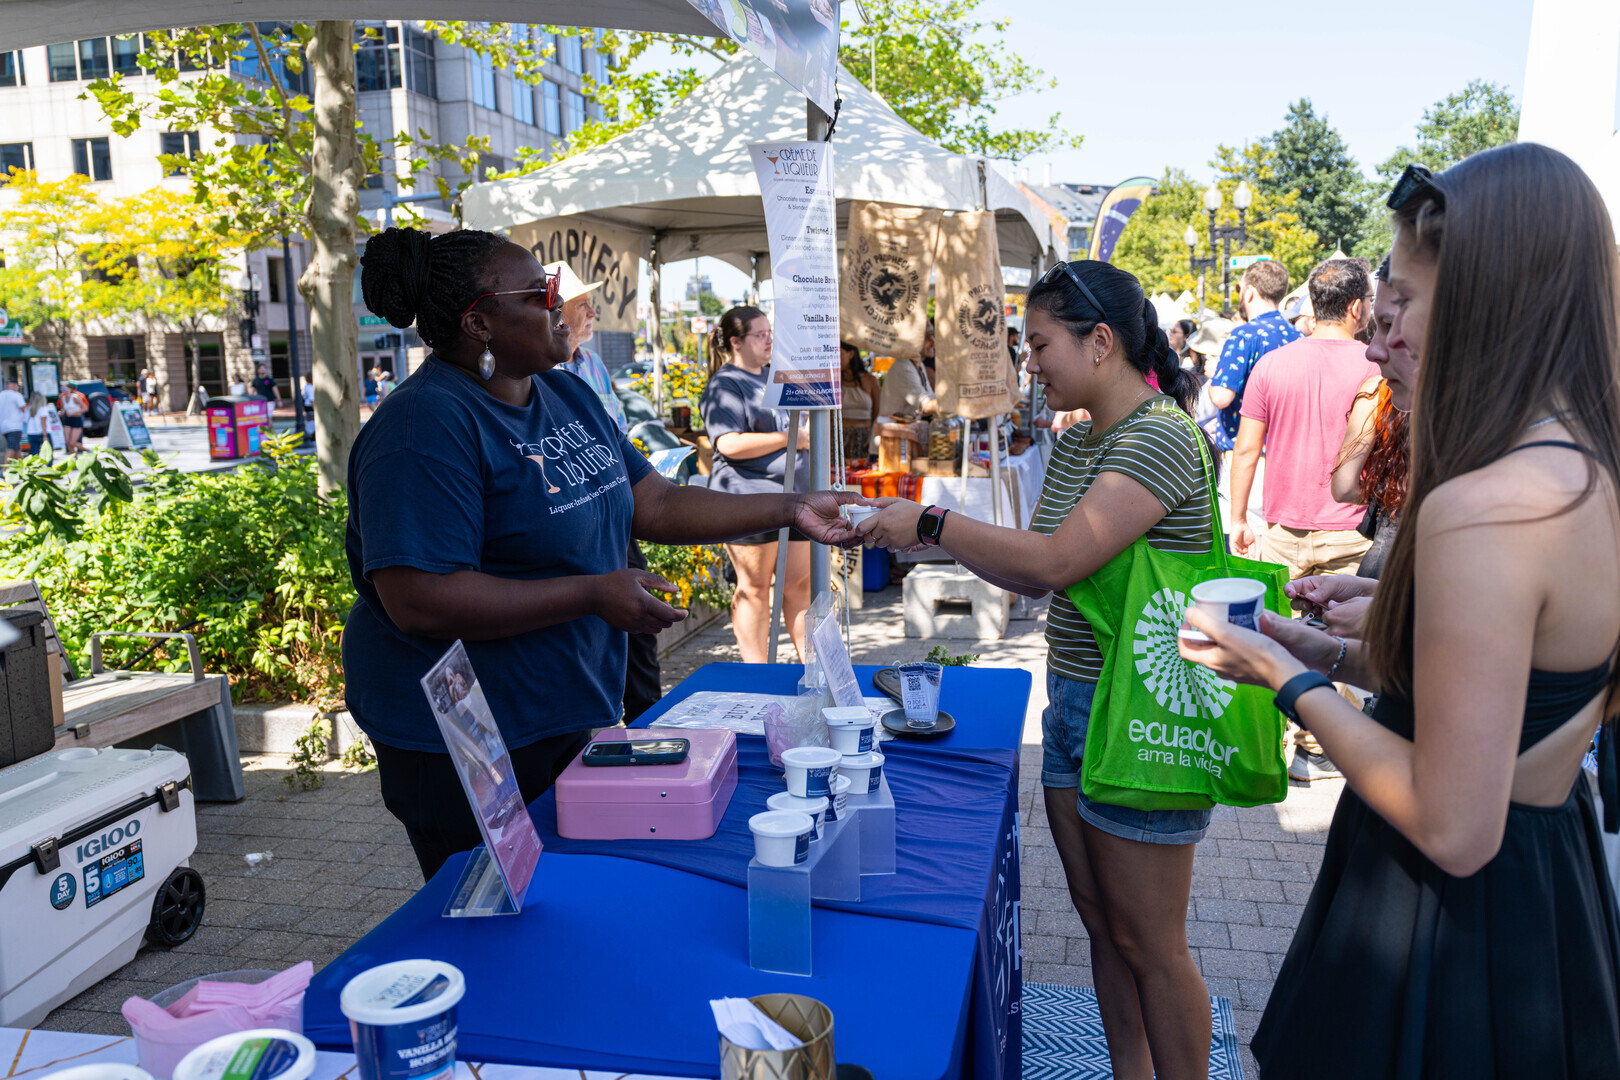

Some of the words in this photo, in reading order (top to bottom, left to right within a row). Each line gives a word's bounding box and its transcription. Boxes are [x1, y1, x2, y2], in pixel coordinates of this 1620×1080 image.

[780, 147, 804, 162] CRÈME
[806, 149, 817, 162] DE
[783, 163, 819, 177] LIQUEUR
[793, 275, 823, 283] Chocolate
[1128, 719, 1239, 767] ecuador
[1137, 748, 1175, 765] ama
[1179, 750, 1192, 767] la
[1193, 753, 1222, 779] vida
[76, 819, 141, 864] IGLOO
[101, 849, 126, 866] IGLOO
[127, 856, 139, 868] 90
[58, 876, 69, 892] 5
[85, 868, 101, 893] 5
[57, 888, 72, 900] DAY
[396, 1038, 445, 1060] VANILLA
